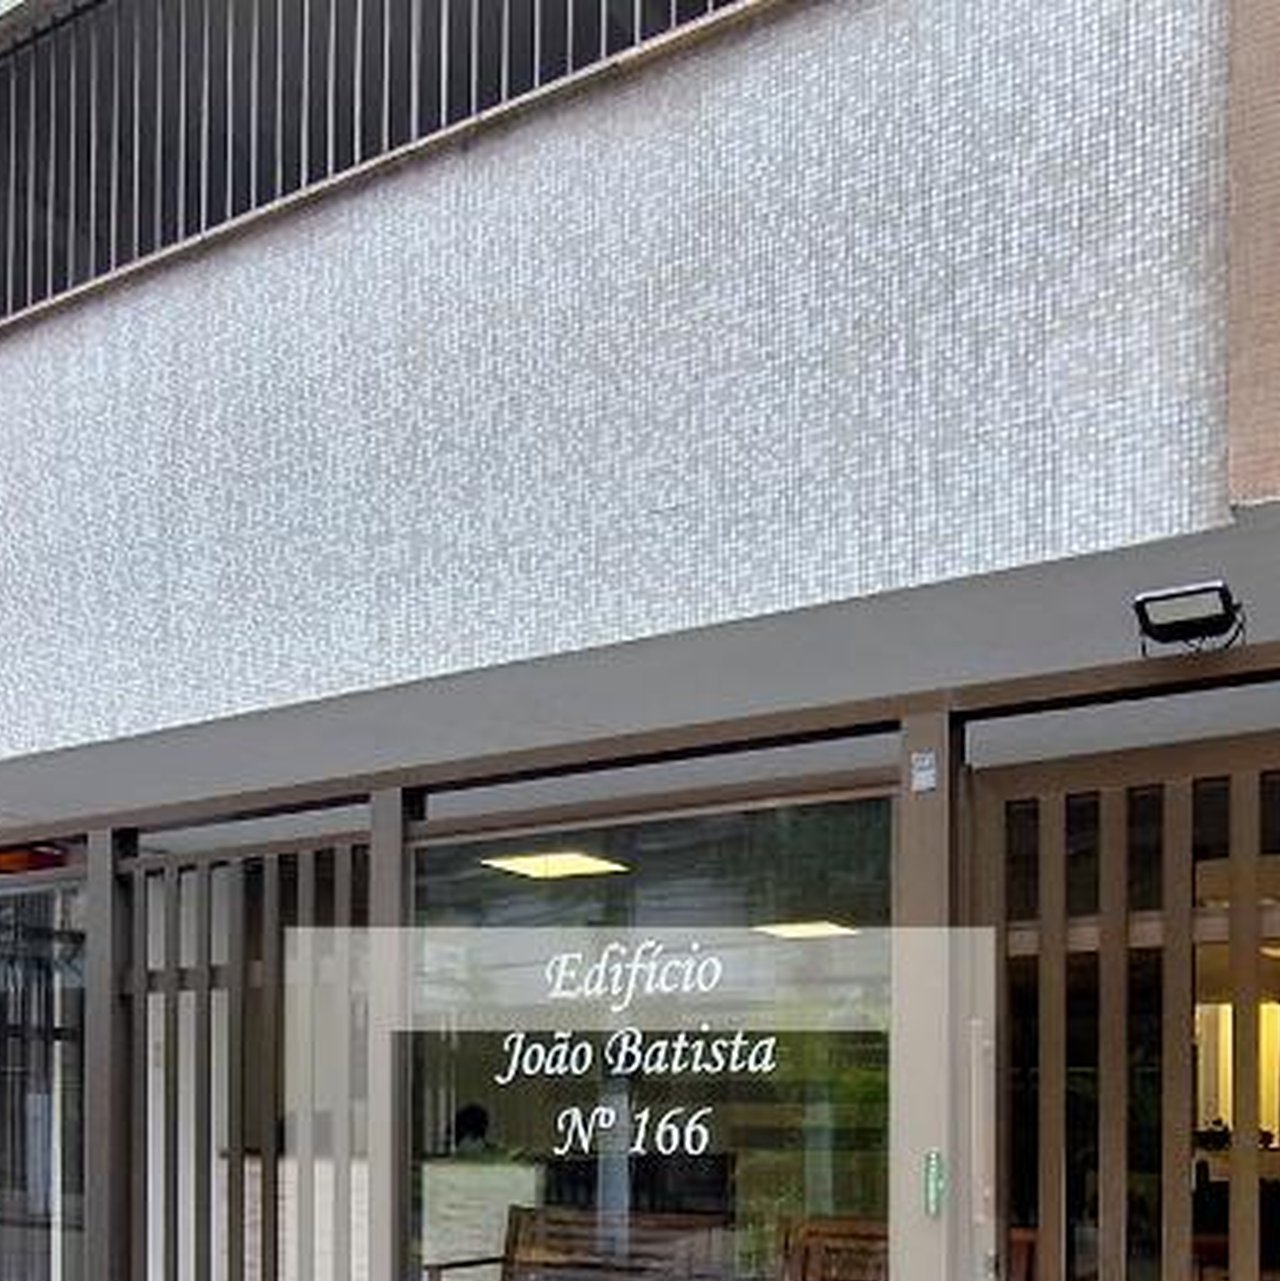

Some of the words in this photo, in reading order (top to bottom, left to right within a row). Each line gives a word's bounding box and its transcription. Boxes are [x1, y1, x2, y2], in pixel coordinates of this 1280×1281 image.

[545, 940, 722, 1012] Edifício
[494, 1030, 592, 1084] João
[605, 1023, 777, 1075] Batista
[629, 1106, 714, 1156] 166
